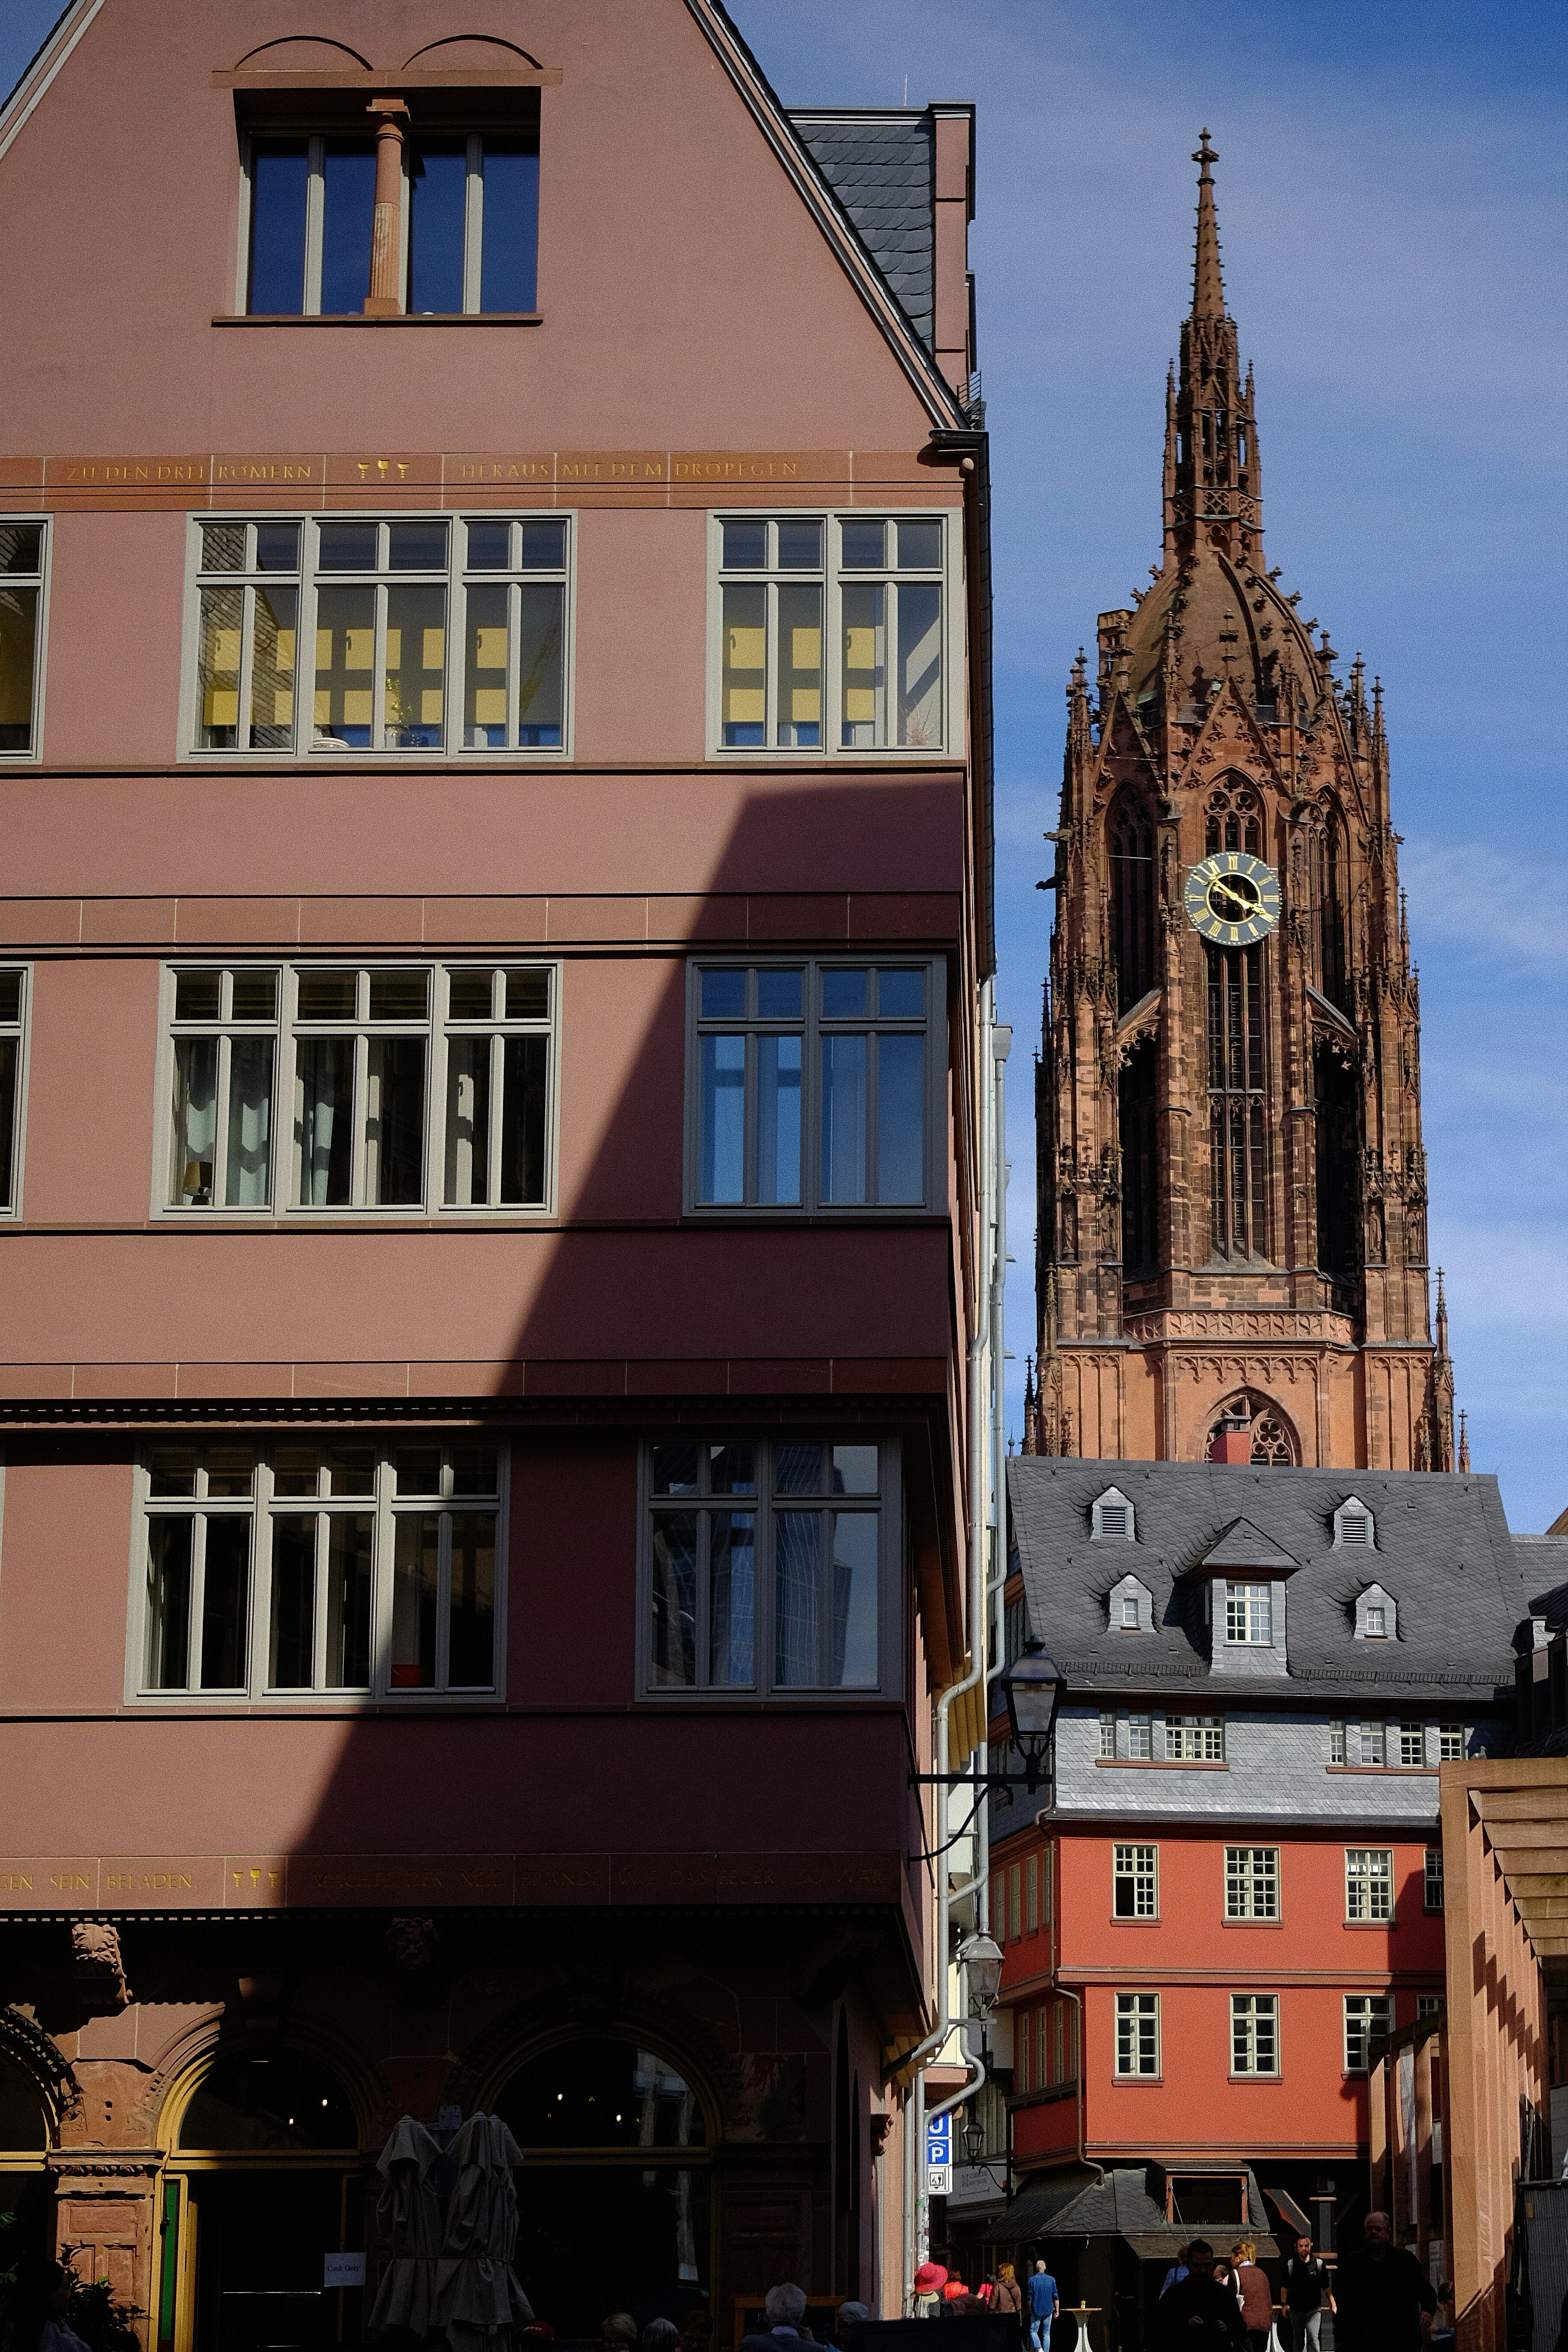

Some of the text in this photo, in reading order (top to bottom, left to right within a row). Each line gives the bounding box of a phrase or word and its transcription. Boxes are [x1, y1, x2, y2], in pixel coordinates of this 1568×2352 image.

[67, 464, 311, 480] ZU DEN DREI RÖMERN
[462, 463, 549, 478] HERAUS
[562, 462, 602, 477] MIT
[612, 462, 662, 477] DEM
[50, 1873, 90, 1890] SEIN
[932, 2146, 944, 2163] P
[344, 2264, 359, 2272] Only
